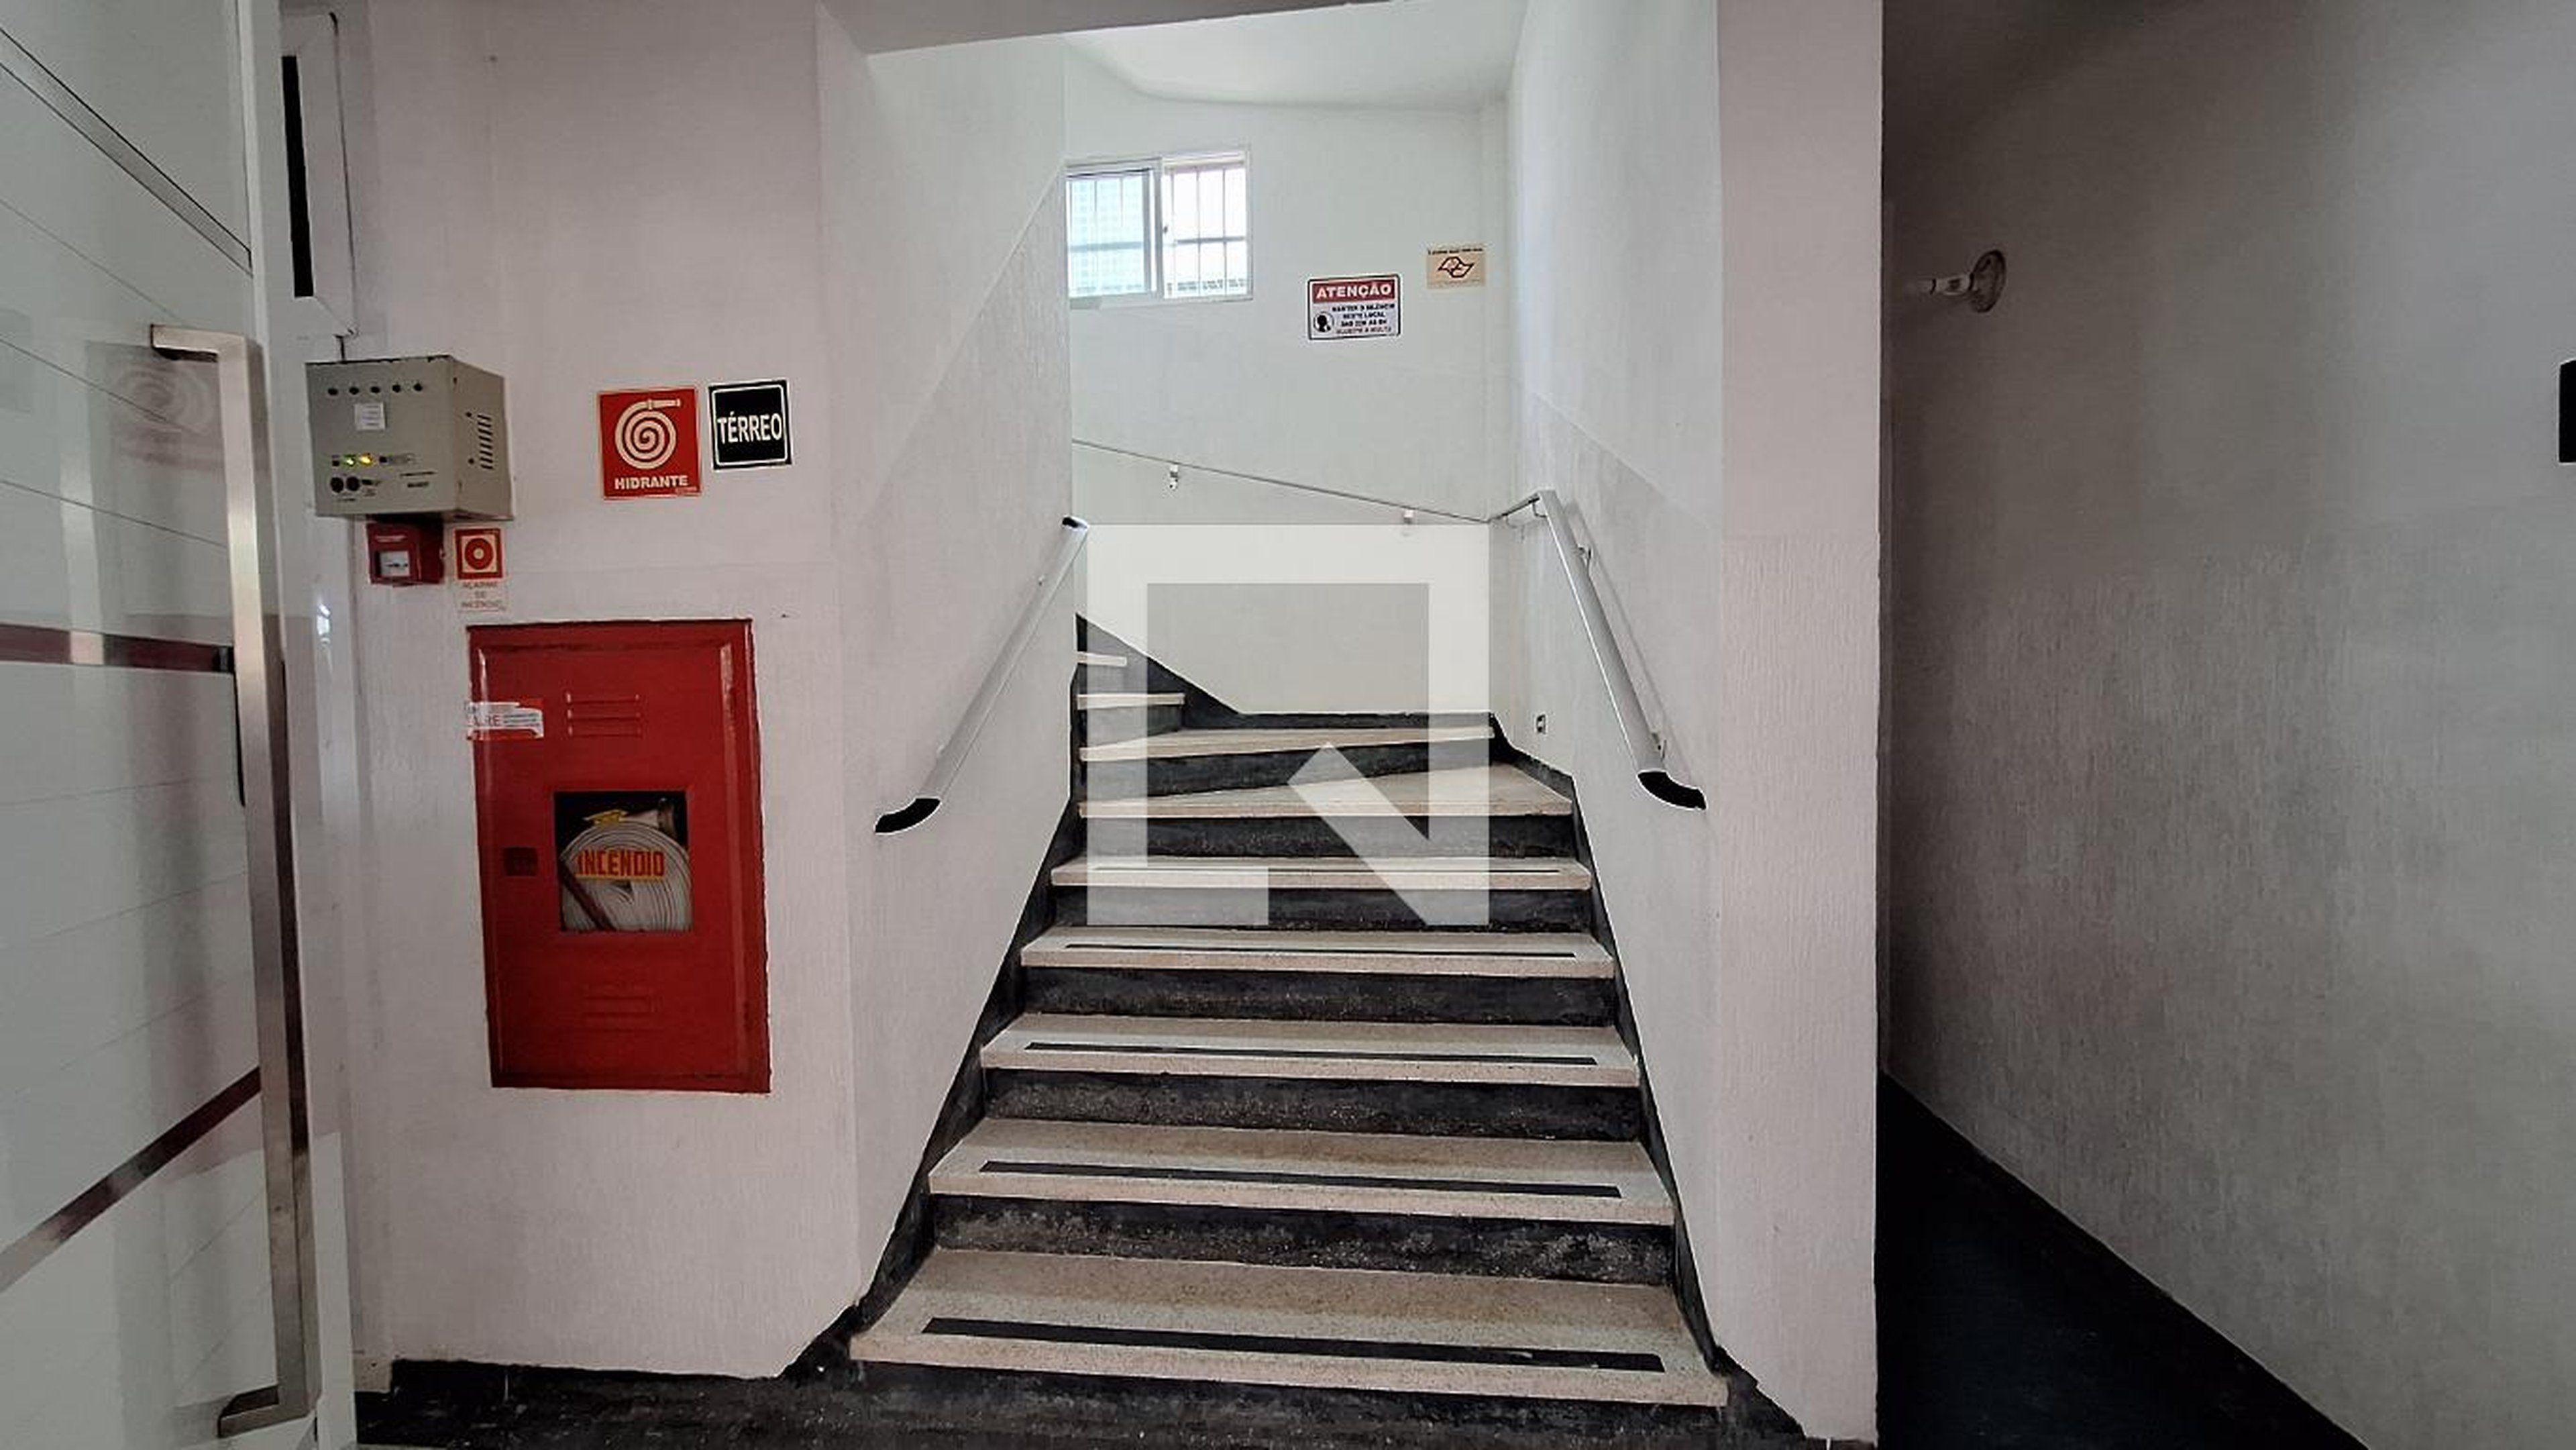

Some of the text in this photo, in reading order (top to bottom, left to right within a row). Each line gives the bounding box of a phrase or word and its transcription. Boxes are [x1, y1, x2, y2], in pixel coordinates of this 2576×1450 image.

[1316, 281, 1392, 299] ATENÇÃO
[717, 411, 783, 444] TÉRREO
[614, 475, 690, 490] HIDRANTE
